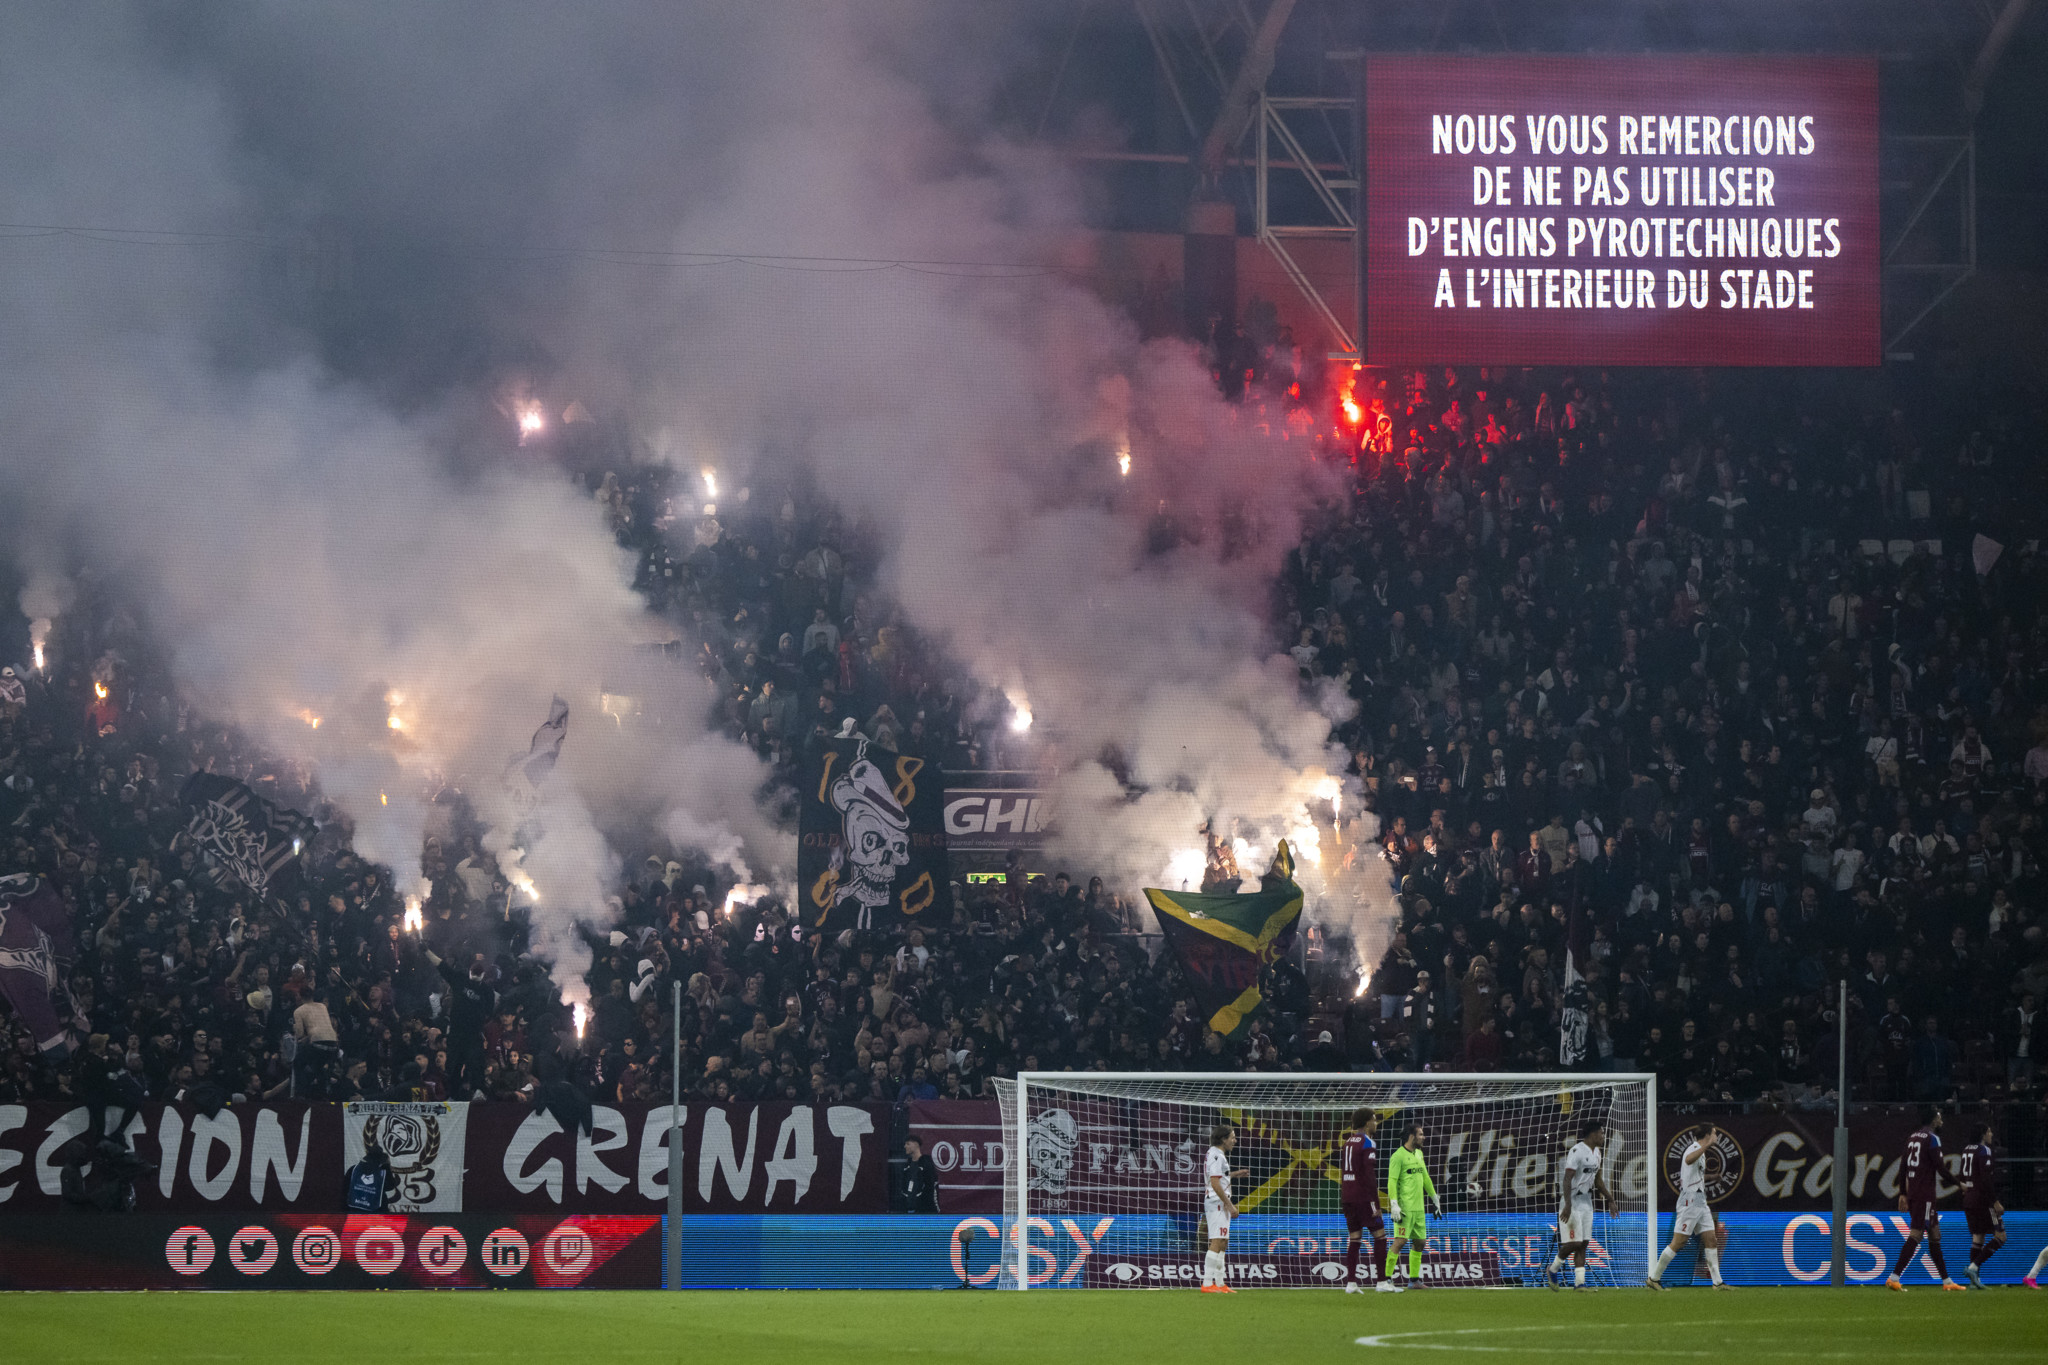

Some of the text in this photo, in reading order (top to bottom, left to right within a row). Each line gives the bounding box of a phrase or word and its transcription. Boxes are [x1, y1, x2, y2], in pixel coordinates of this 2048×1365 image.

[1432, 114, 1815, 156] NOUS VOUS REMERCIONS
[1473, 166, 1776, 207] DE NE PAS UTILISER
[1408, 217, 1841, 259] D’ENGINS PYROTECHNIQUES
[1434, 268, 1815, 309] A L’INTERIEUR DU STADE
[803, 832, 841, 848] OLD
[503, 1104, 875, 1205] GRENAT
[931, 1139, 1199, 1175] OLD FANS
[1907, 1141, 1921, 1167] 23
[1219, 1227, 1228, 1237] 19
[1682, 1223, 1688, 1232] 2
[949, 1216, 1116, 1284] CSX
